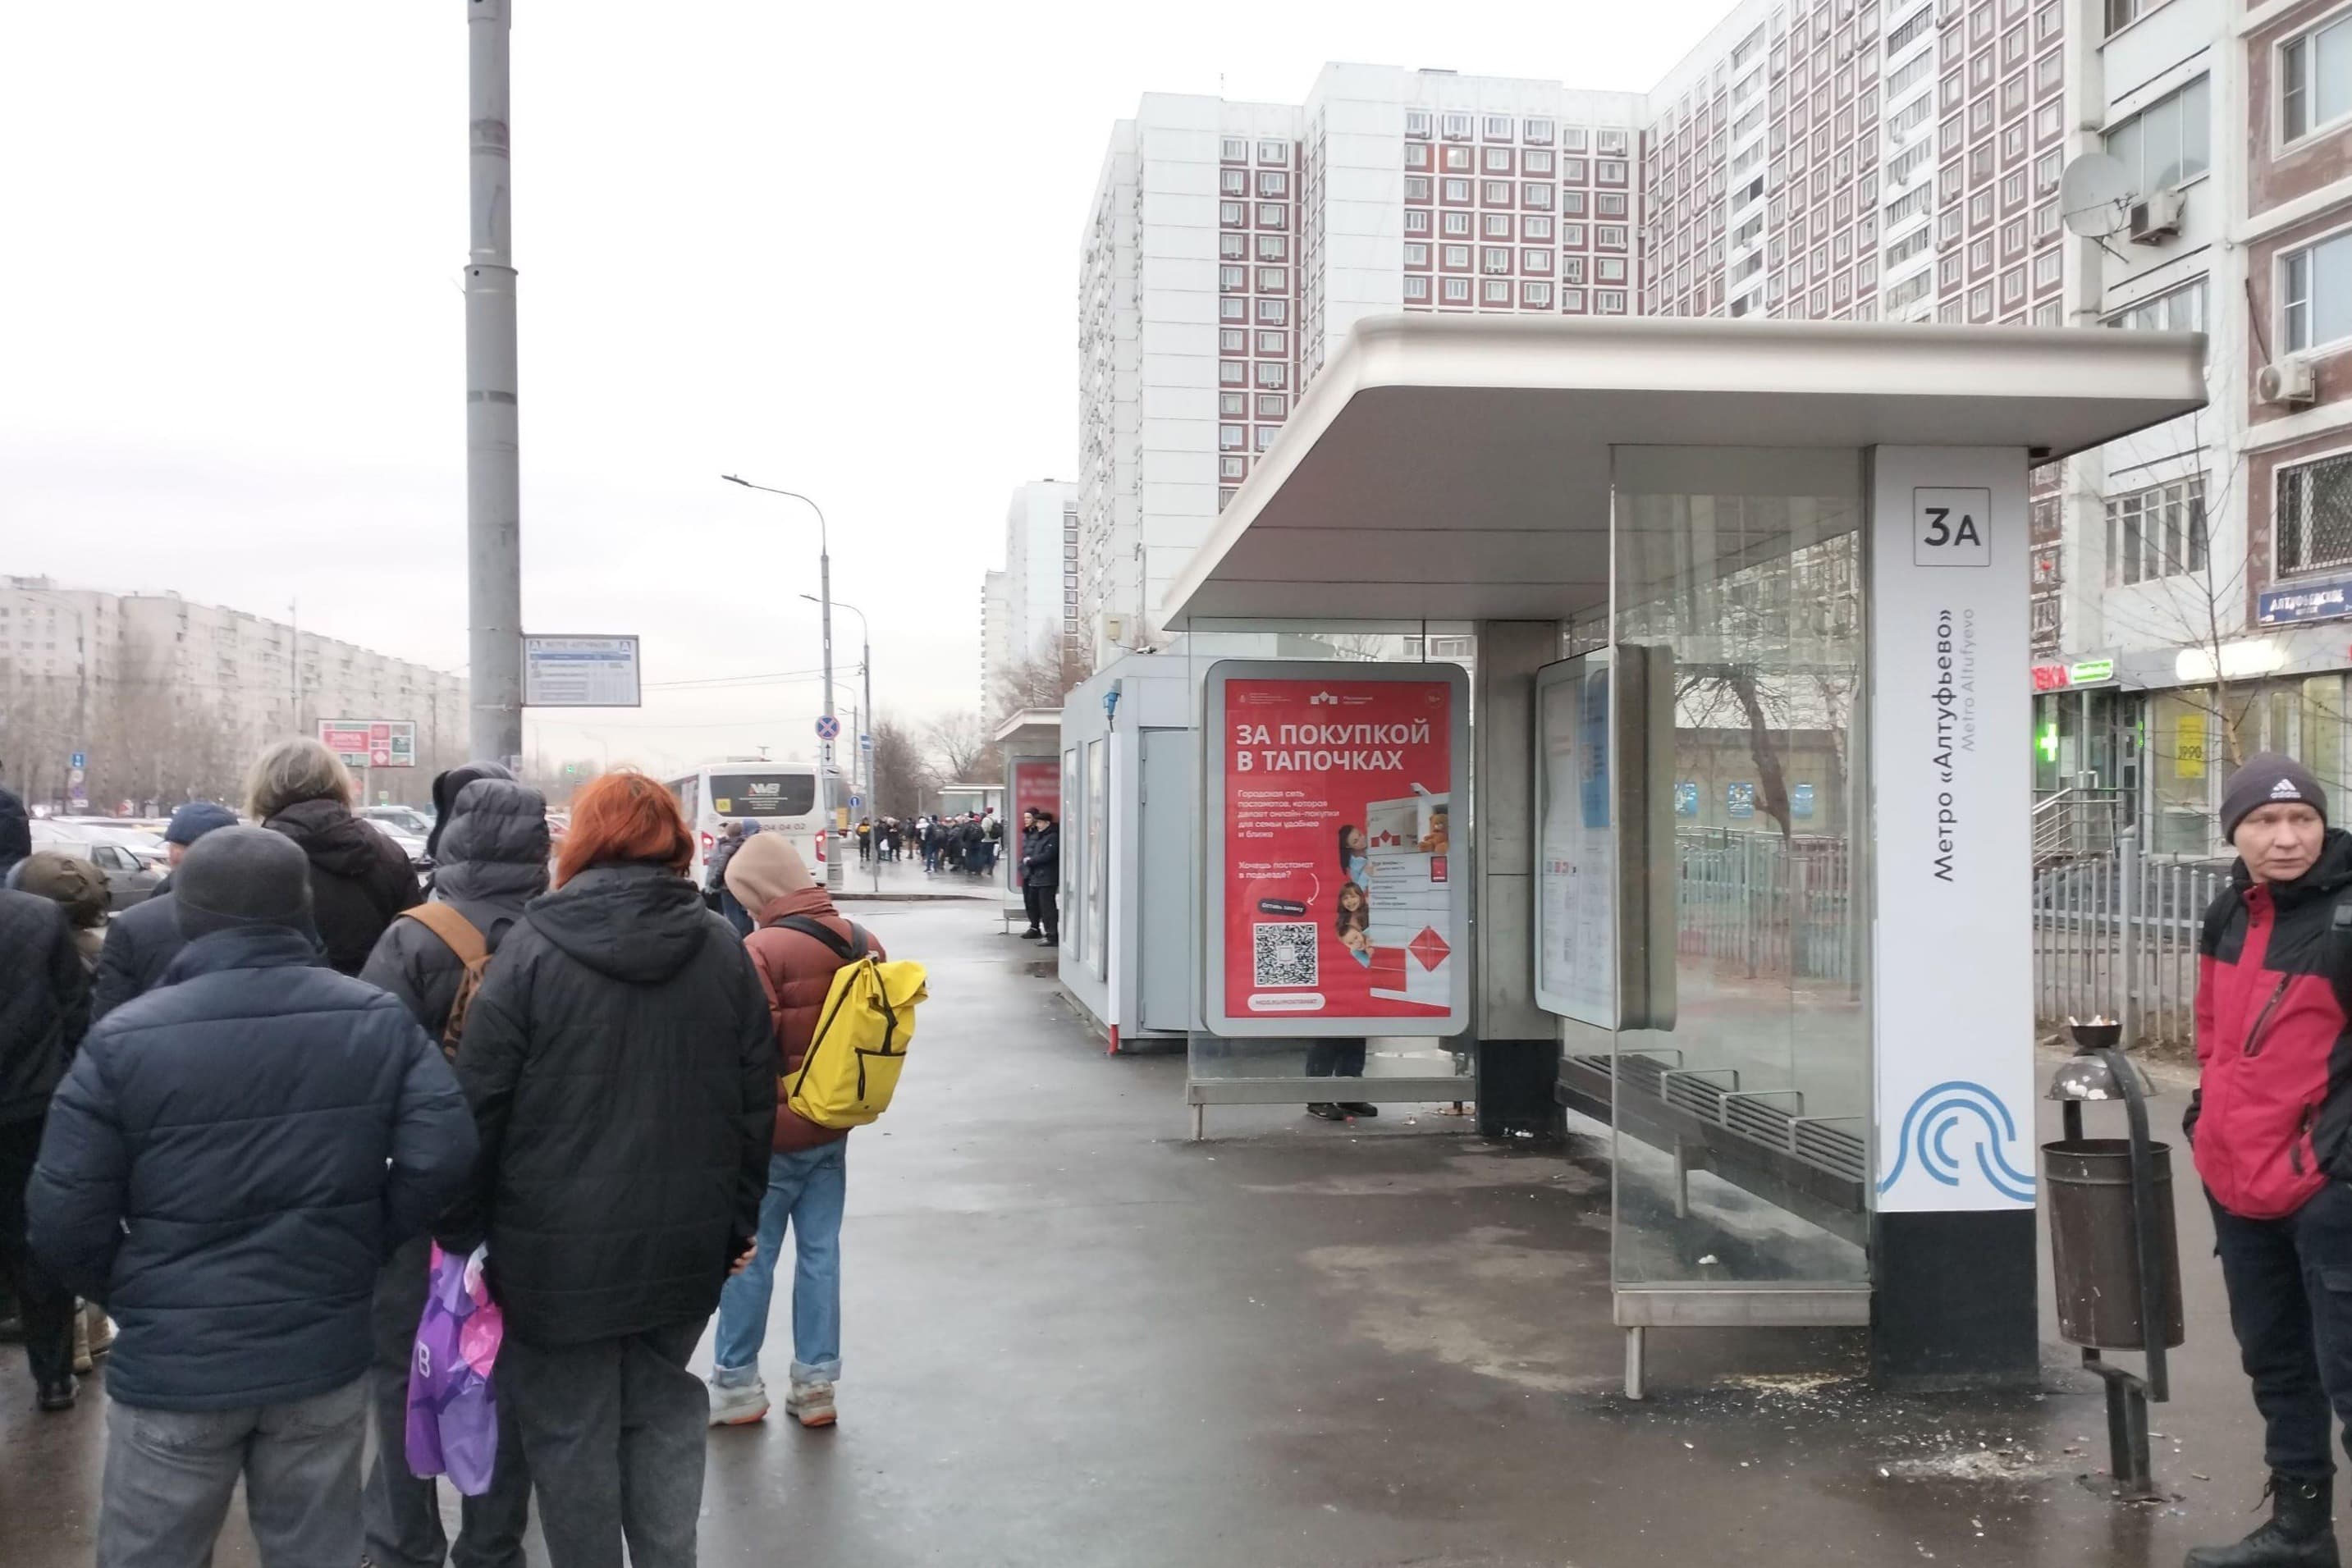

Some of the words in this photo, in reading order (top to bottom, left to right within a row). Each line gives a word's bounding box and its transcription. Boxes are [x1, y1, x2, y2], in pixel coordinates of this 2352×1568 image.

[1924, 507, 1981, 546] 3А
[1959, 608, 1977, 693] Altufyevo
[1931, 610, 1957, 783] «Алтуфьево»
[1236, 724, 1271, 745] ЗА
[1279, 718, 1430, 745] ПОКУПКОЙ
[1961, 697, 1976, 752] Metro
[1237, 751, 1253, 771] В
[1261, 750, 1404, 771] ТАПОЧКАХ
[1933, 792, 1959, 882] Метро
